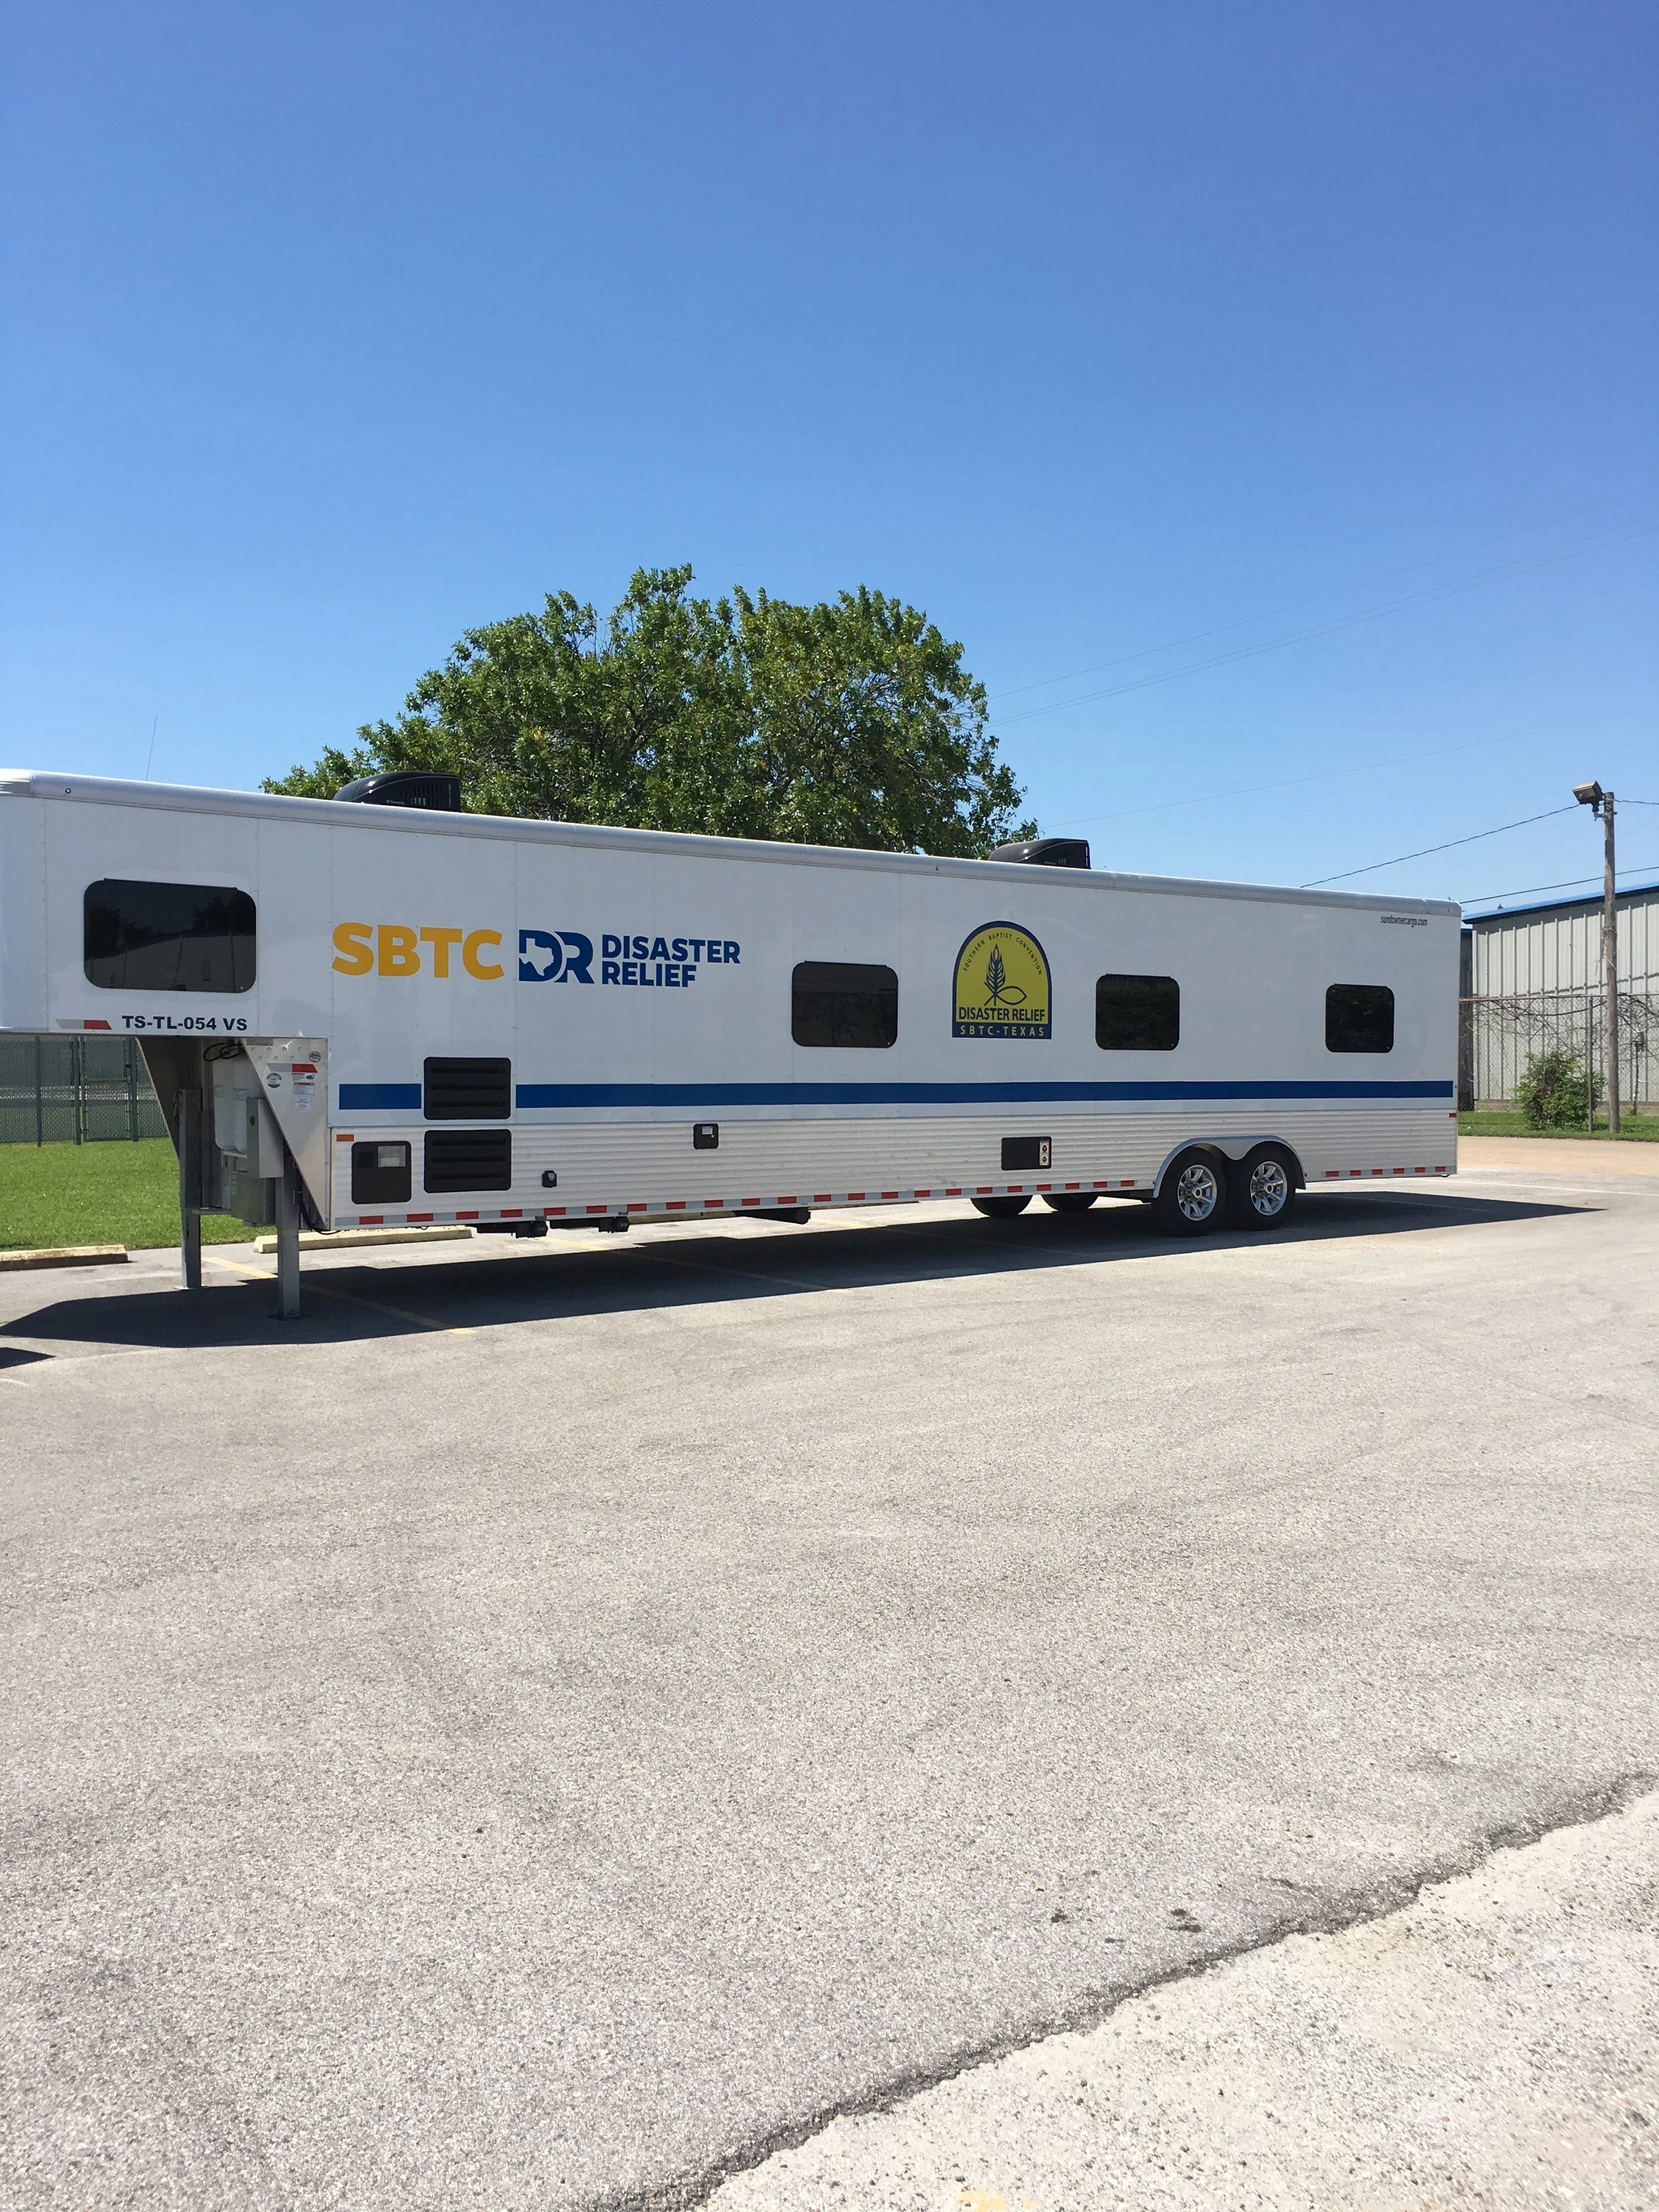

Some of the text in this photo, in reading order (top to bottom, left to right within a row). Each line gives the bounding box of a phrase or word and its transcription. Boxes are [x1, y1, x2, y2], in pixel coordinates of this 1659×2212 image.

[1380, 915, 1427, 928] sundownercargo.com
[332, 922, 594, 984] SBTC DR
[602, 934, 741, 964] DISASTER
[963, 932, 1043, 975] SOUTHERN BAPTIST CONVENTION
[602, 961, 697, 988] RELIEF
[121, 1015, 248, 1031] TS-TL-054 VS
[959, 1007, 1045, 1022] DISASTER RELIEF
[960, 1025, 1044, 1037] SBTC-TEXAS
